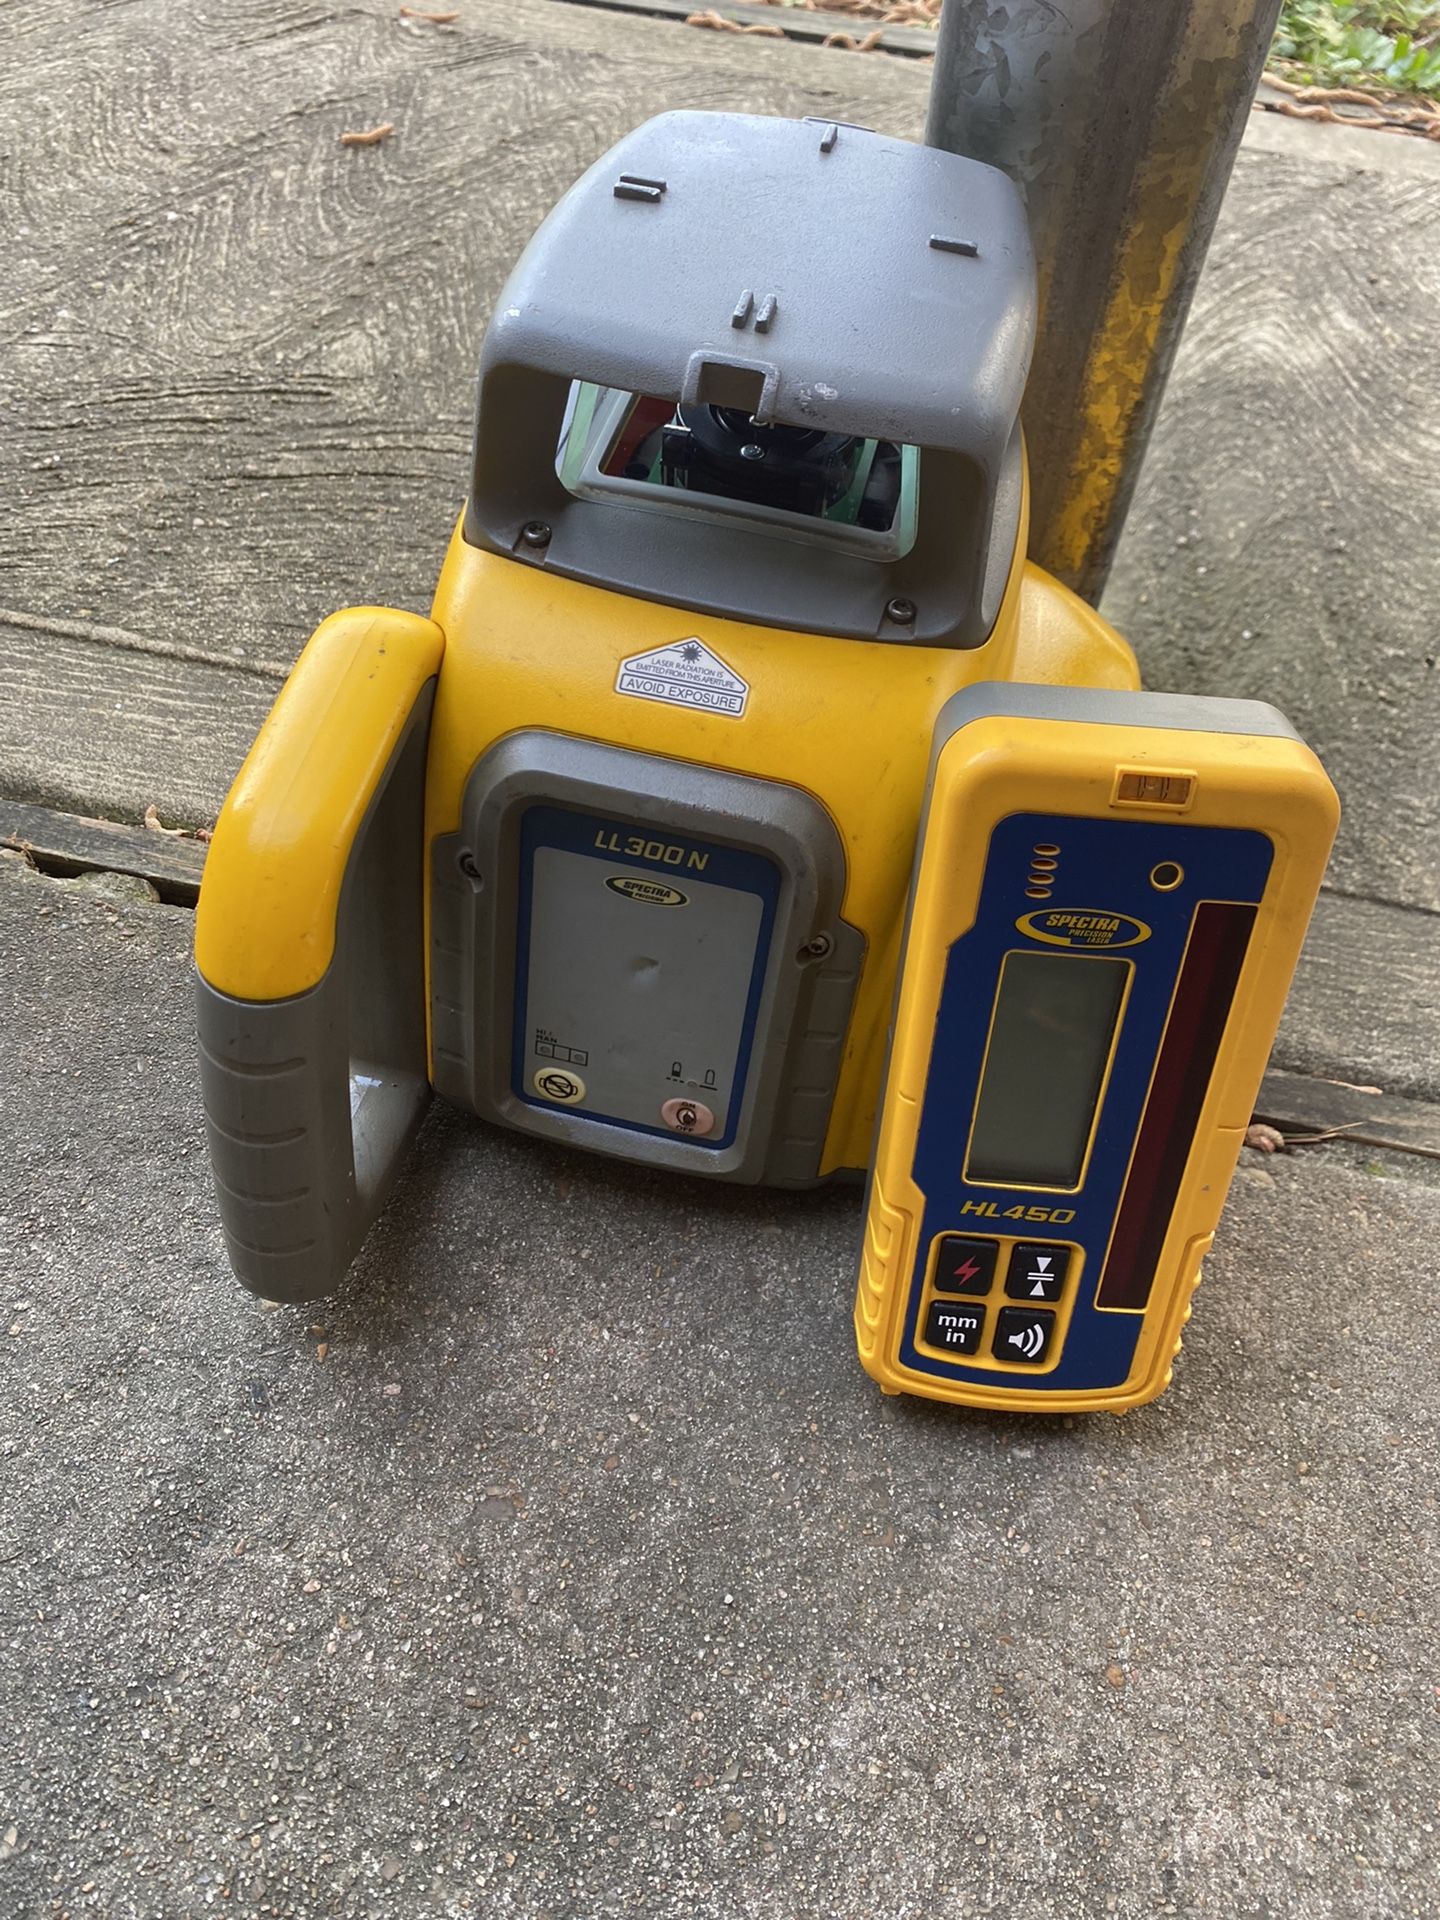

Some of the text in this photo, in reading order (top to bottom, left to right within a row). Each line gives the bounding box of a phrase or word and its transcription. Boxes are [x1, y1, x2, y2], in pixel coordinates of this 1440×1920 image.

[636, 663, 736, 688] EMITTED FROM THIS APERTURE
[651, 658, 724, 678] LASER RADIATION IS
[626, 678, 738, 709] AVOID EXPOSURE
[623, 881, 672, 898] SPECTRA
[1046, 914, 1121, 931] SPECTRA
[1068, 929, 1114, 939] PRECISION
[960, 1200, 1076, 1224] HL450
[938, 1314, 977, 1330] mm
[945, 1328, 966, 1344] in
